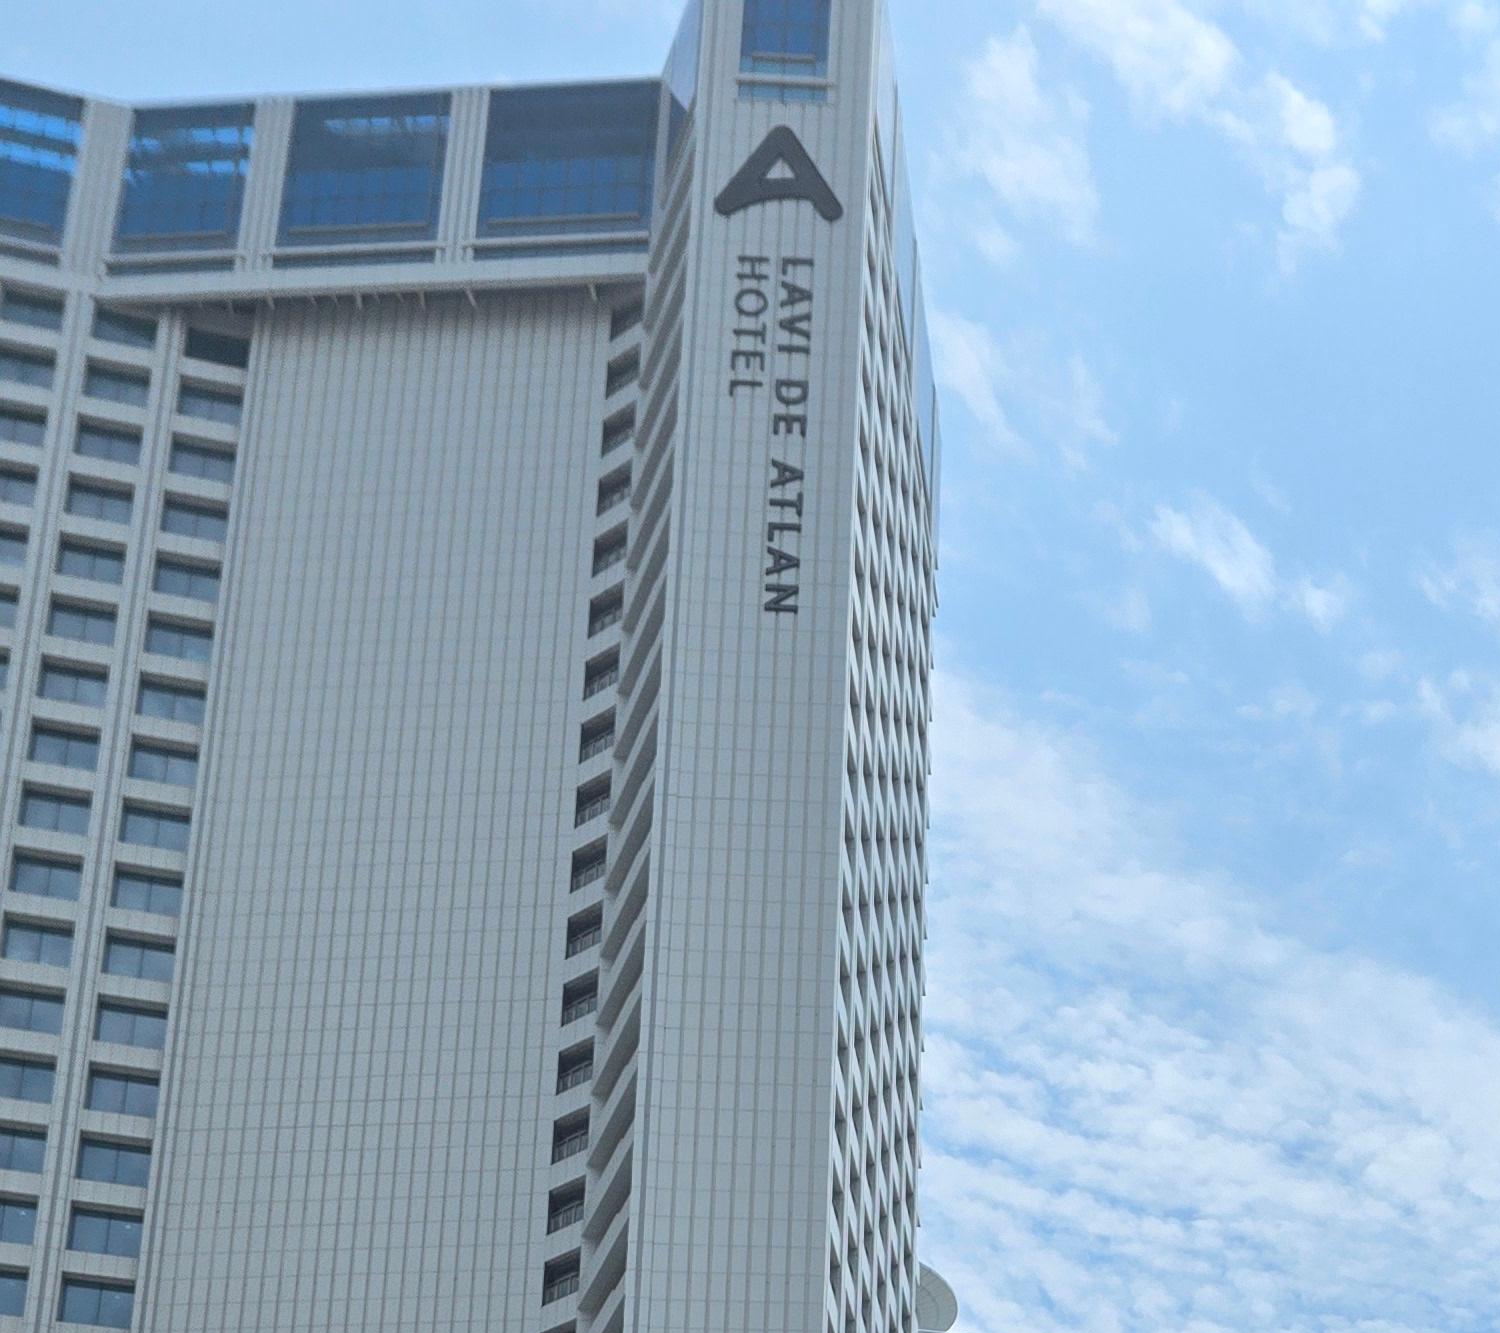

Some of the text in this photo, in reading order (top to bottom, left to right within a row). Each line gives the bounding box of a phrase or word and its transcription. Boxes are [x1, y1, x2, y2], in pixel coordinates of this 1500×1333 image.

[728, 254, 770, 397] HOTEL
[764, 255, 813, 615] LAVI DE ATLAN
